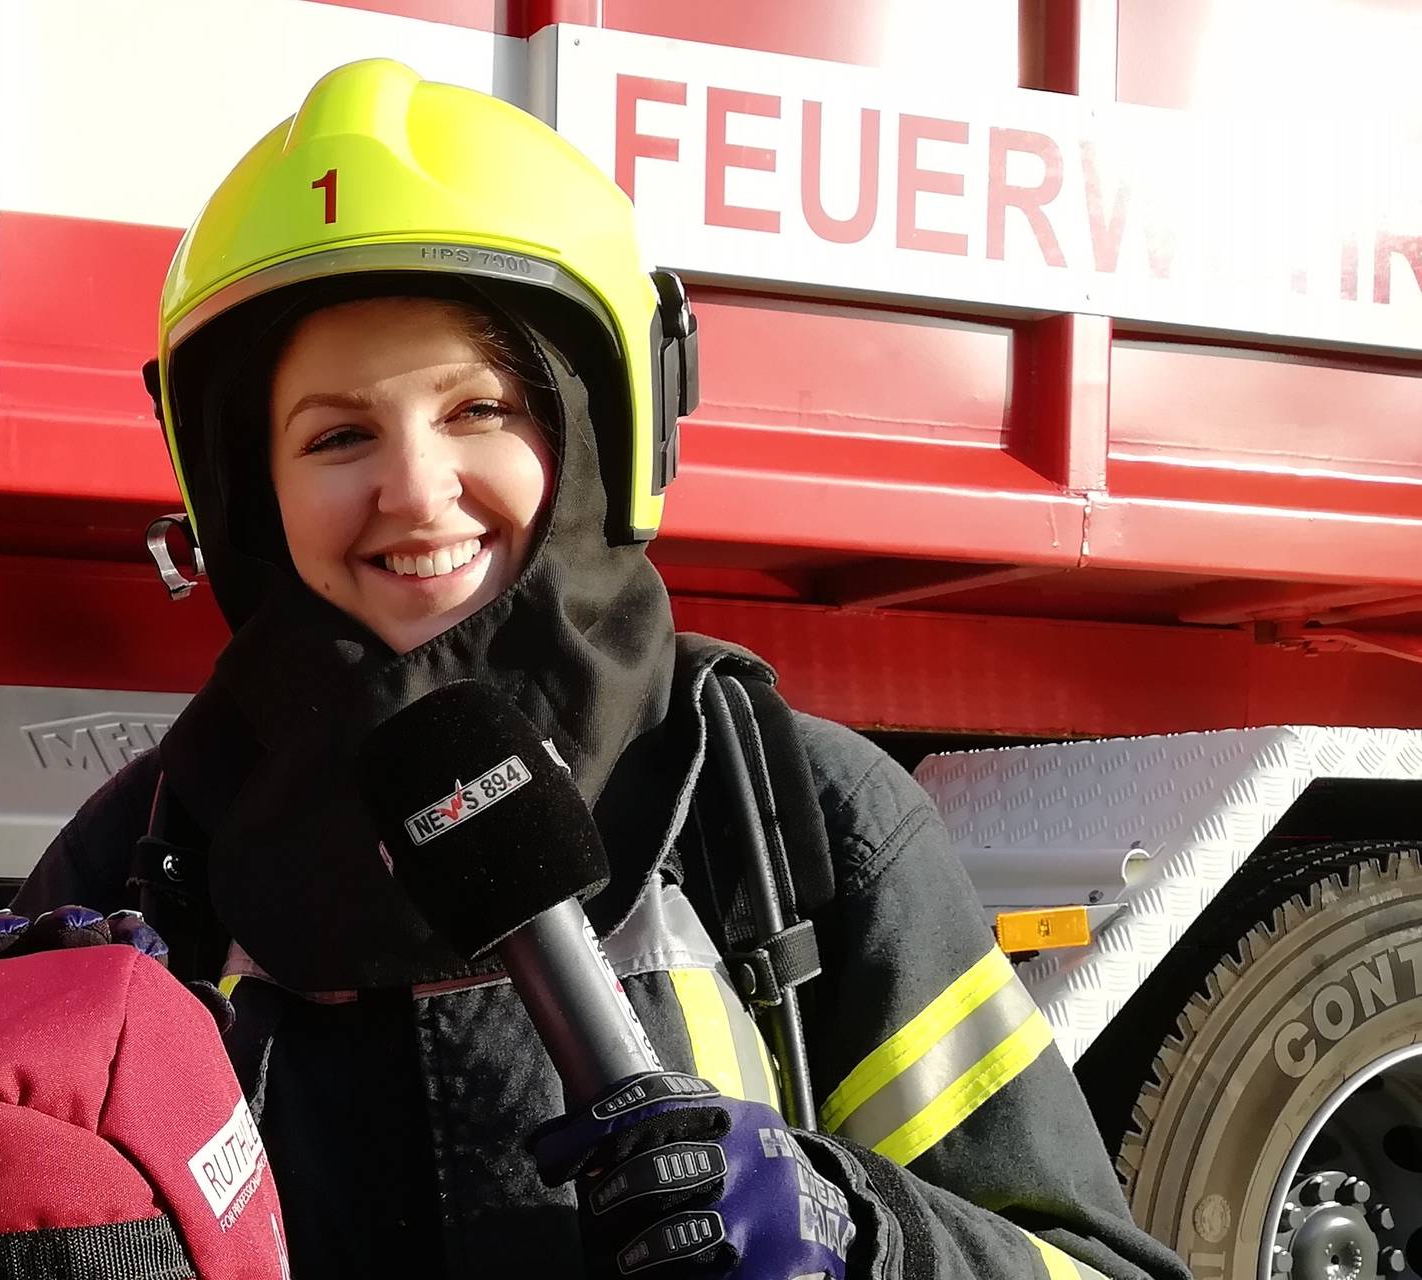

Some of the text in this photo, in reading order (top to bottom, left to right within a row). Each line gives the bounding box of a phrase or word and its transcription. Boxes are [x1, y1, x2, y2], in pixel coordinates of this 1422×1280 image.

[311, 168, 338, 224] 1
[615, 72, 1422, 306] FEUERW
[420, 247, 470, 263] HPS
[412, 764, 522, 839] NEWS 89.4
